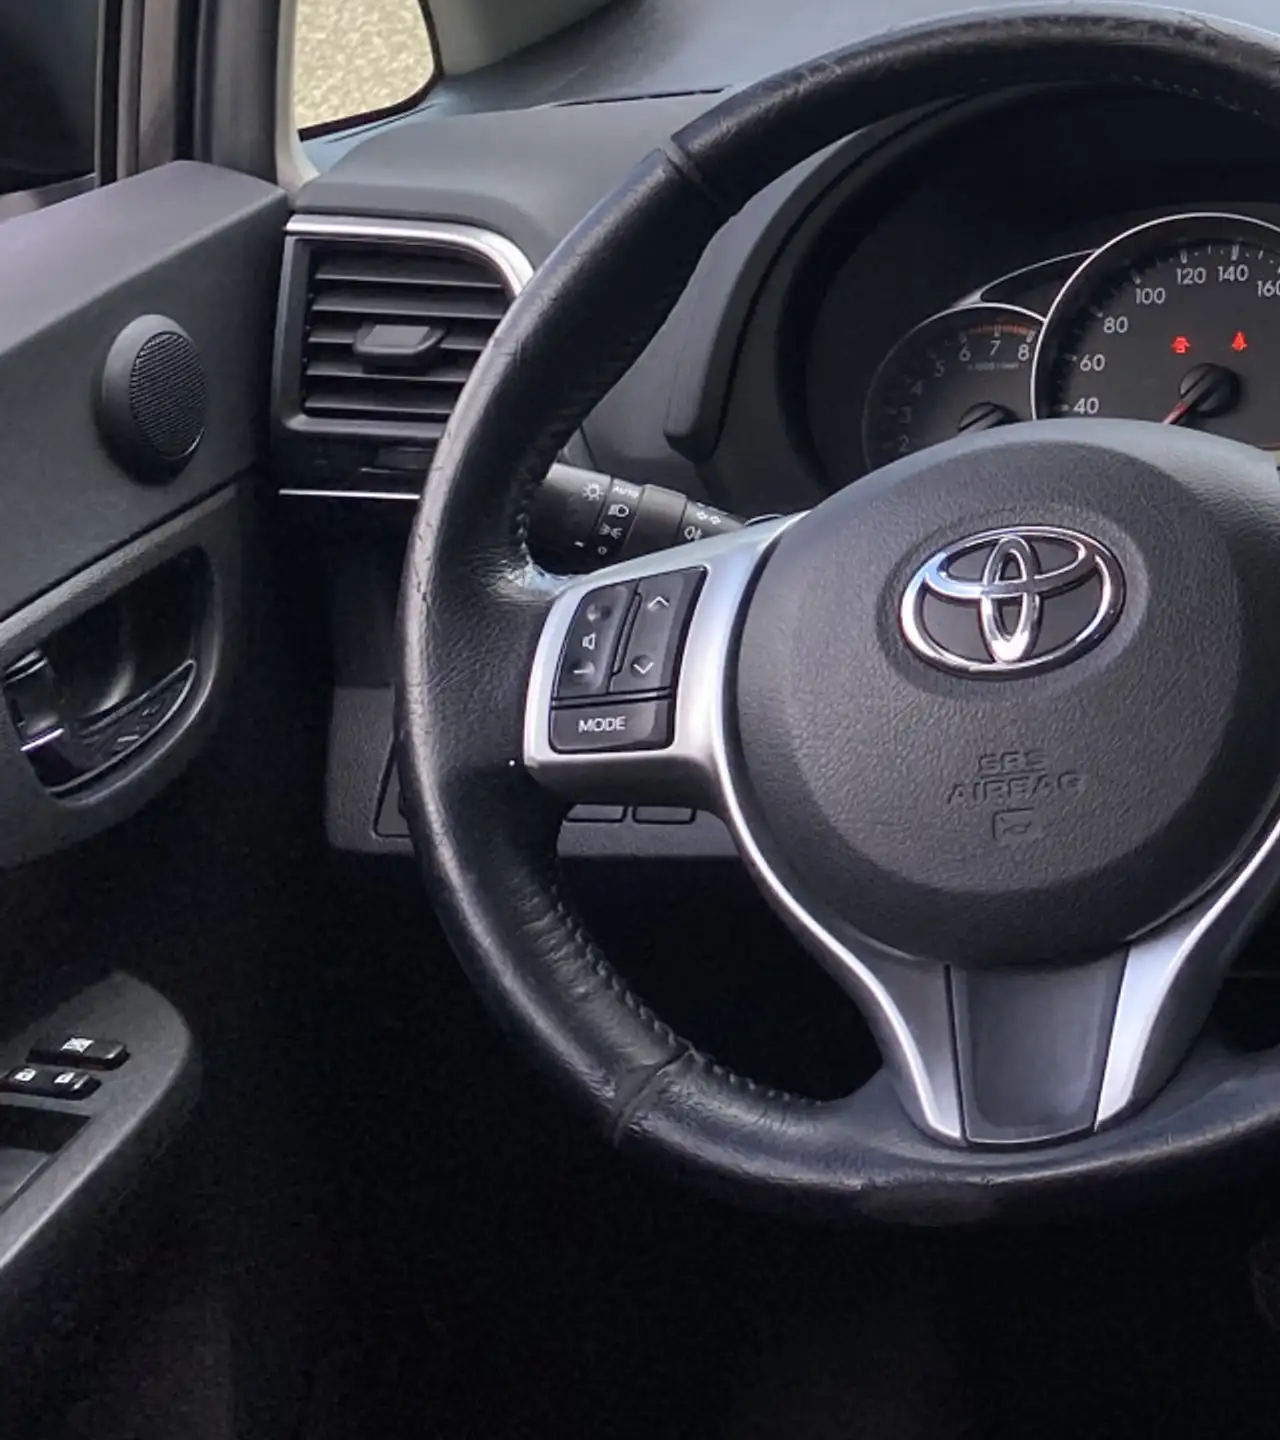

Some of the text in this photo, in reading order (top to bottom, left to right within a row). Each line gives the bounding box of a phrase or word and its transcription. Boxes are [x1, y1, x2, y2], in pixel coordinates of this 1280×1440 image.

[1176, 268, 1206, 284] 120
[1217, 265, 1249, 281] 140
[1135, 288, 1166, 304] 100
[1103, 316, 1128, 333] 80
[959, 347, 971, 361] 6
[990, 340, 1001, 356] 7
[1017, 344, 1030, 361] 8
[1080, 354, 1105, 371] 60
[1073, 397, 1099, 414] 40
[578, 716, 626, 733] MODE
